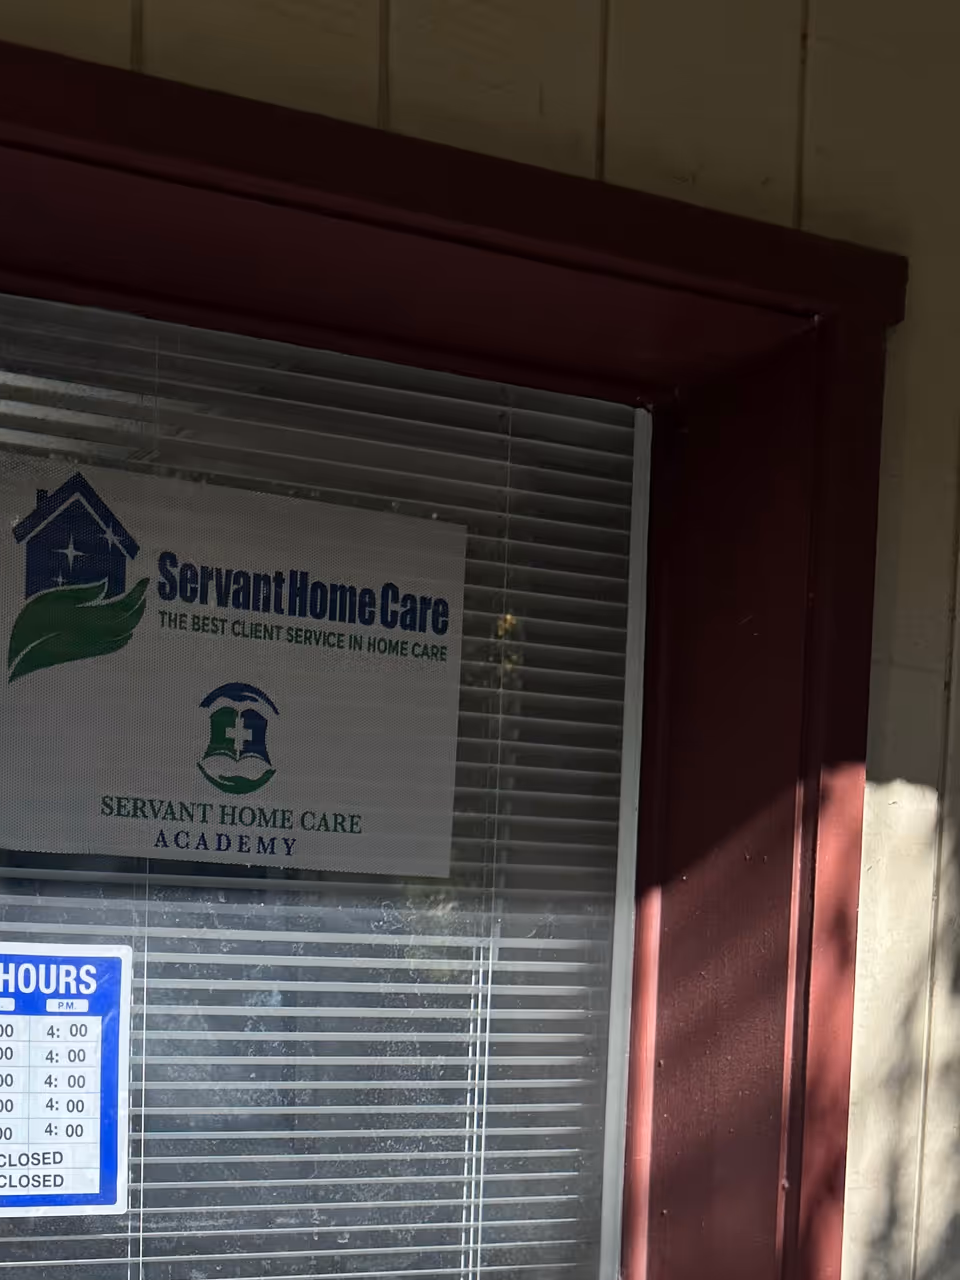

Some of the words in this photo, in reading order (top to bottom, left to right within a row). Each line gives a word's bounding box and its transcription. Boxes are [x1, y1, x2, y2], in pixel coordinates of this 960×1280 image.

[158, 610, 188, 632] THE
[191, 615, 228, 636] BEST
[231, 619, 284, 642] CLIENT
[286, 625, 345, 650] SERVICE
[348, 634, 364, 651] IN
[367, 636, 409, 657] HOME
[411, 642, 448, 663] CARE
[100, 794, 215, 826] SERVANT
[218, 804, 294, 830] HOME
[299, 810, 363, 835] CARE
[153, 829, 297, 857] ACADEMY
